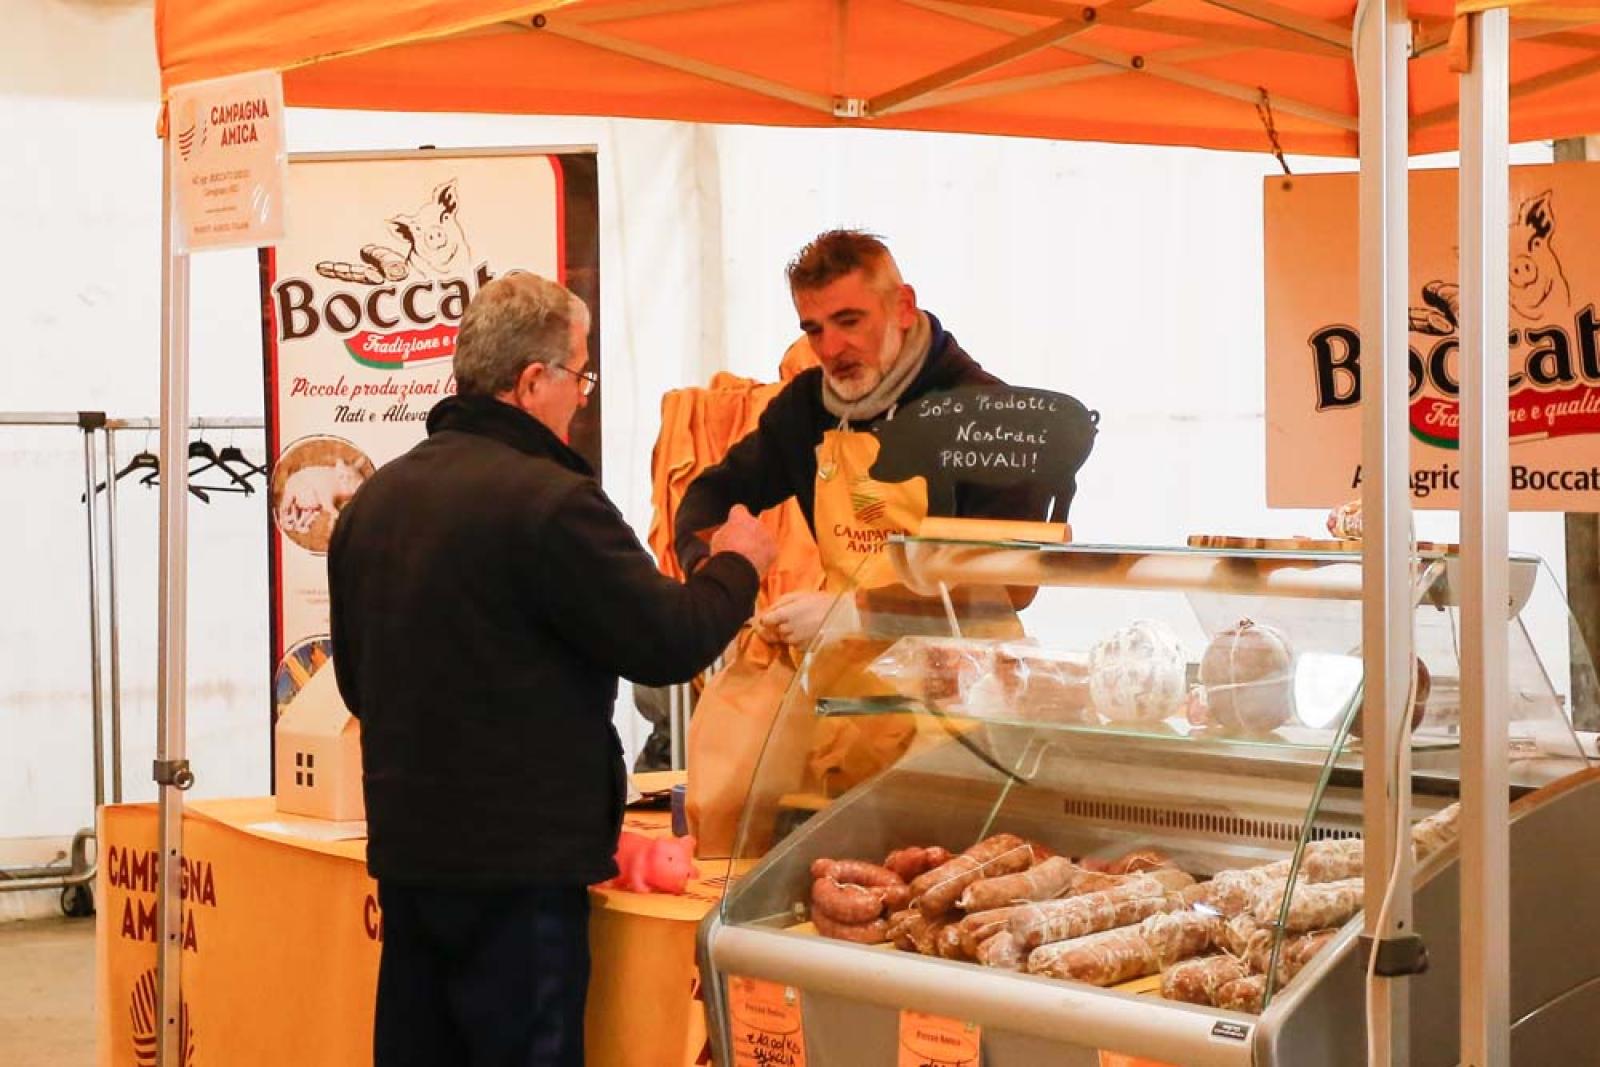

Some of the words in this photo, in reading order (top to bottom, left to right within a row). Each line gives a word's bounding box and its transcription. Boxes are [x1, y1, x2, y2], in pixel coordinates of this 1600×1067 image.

[210, 98, 270, 126] CAMPAGNA
[220, 124, 259, 148] AMICA
[290, 376, 349, 398] Piccole
[350, 376, 440, 406] produzioni
[334, 405, 365, 424] Nati
[369, 411, 376, 422] e
[1531, 404, 1542, 420] e
[940, 450, 1038, 473] PROVALI!
